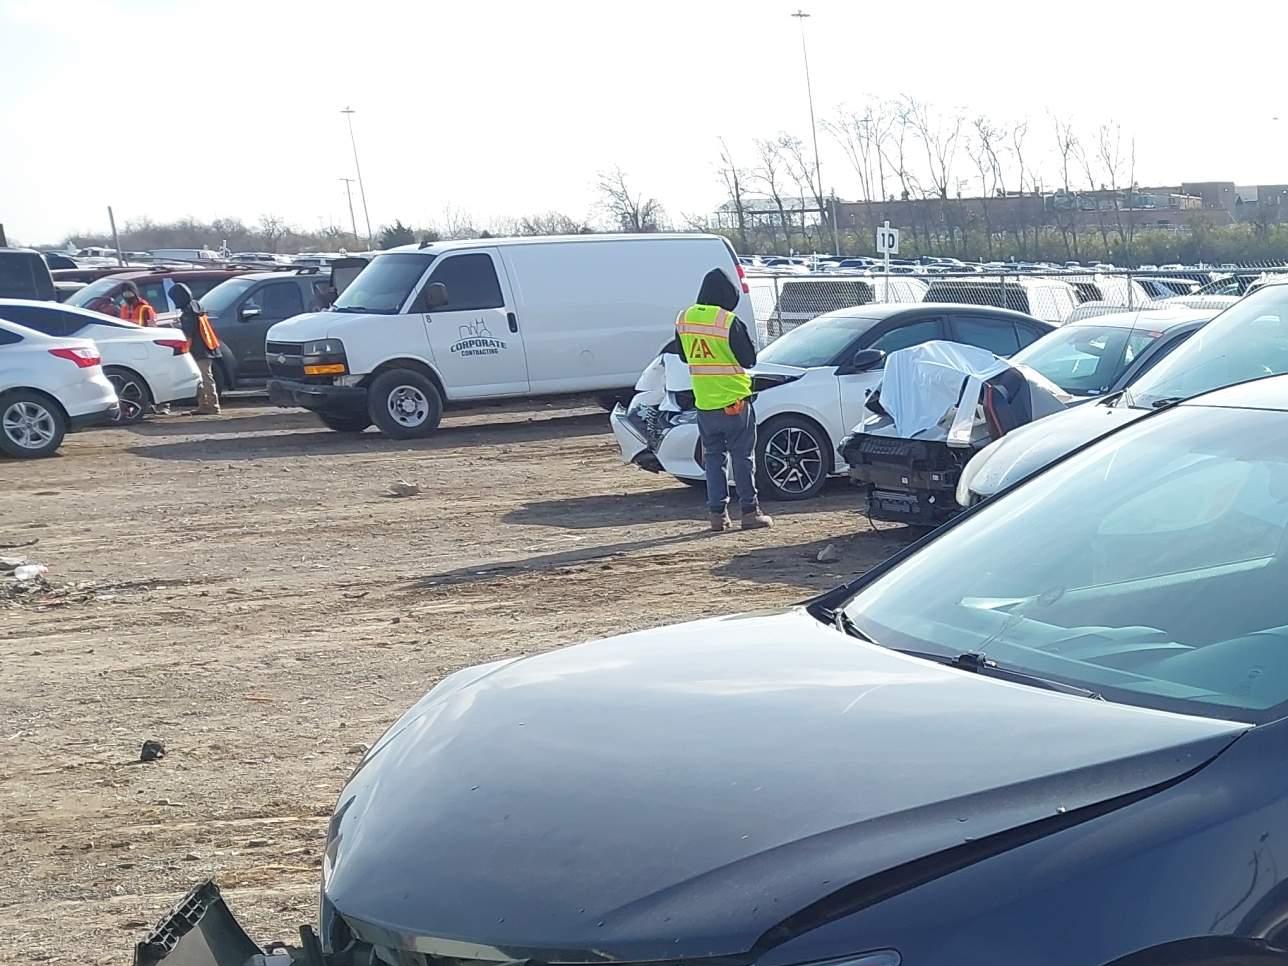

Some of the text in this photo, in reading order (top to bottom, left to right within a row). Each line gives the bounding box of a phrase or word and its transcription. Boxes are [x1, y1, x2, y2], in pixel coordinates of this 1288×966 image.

[425, 314, 432, 323] 8
[450, 339, 507, 353] CORPORATE
[461, 348, 499, 357] CONTRACTING
